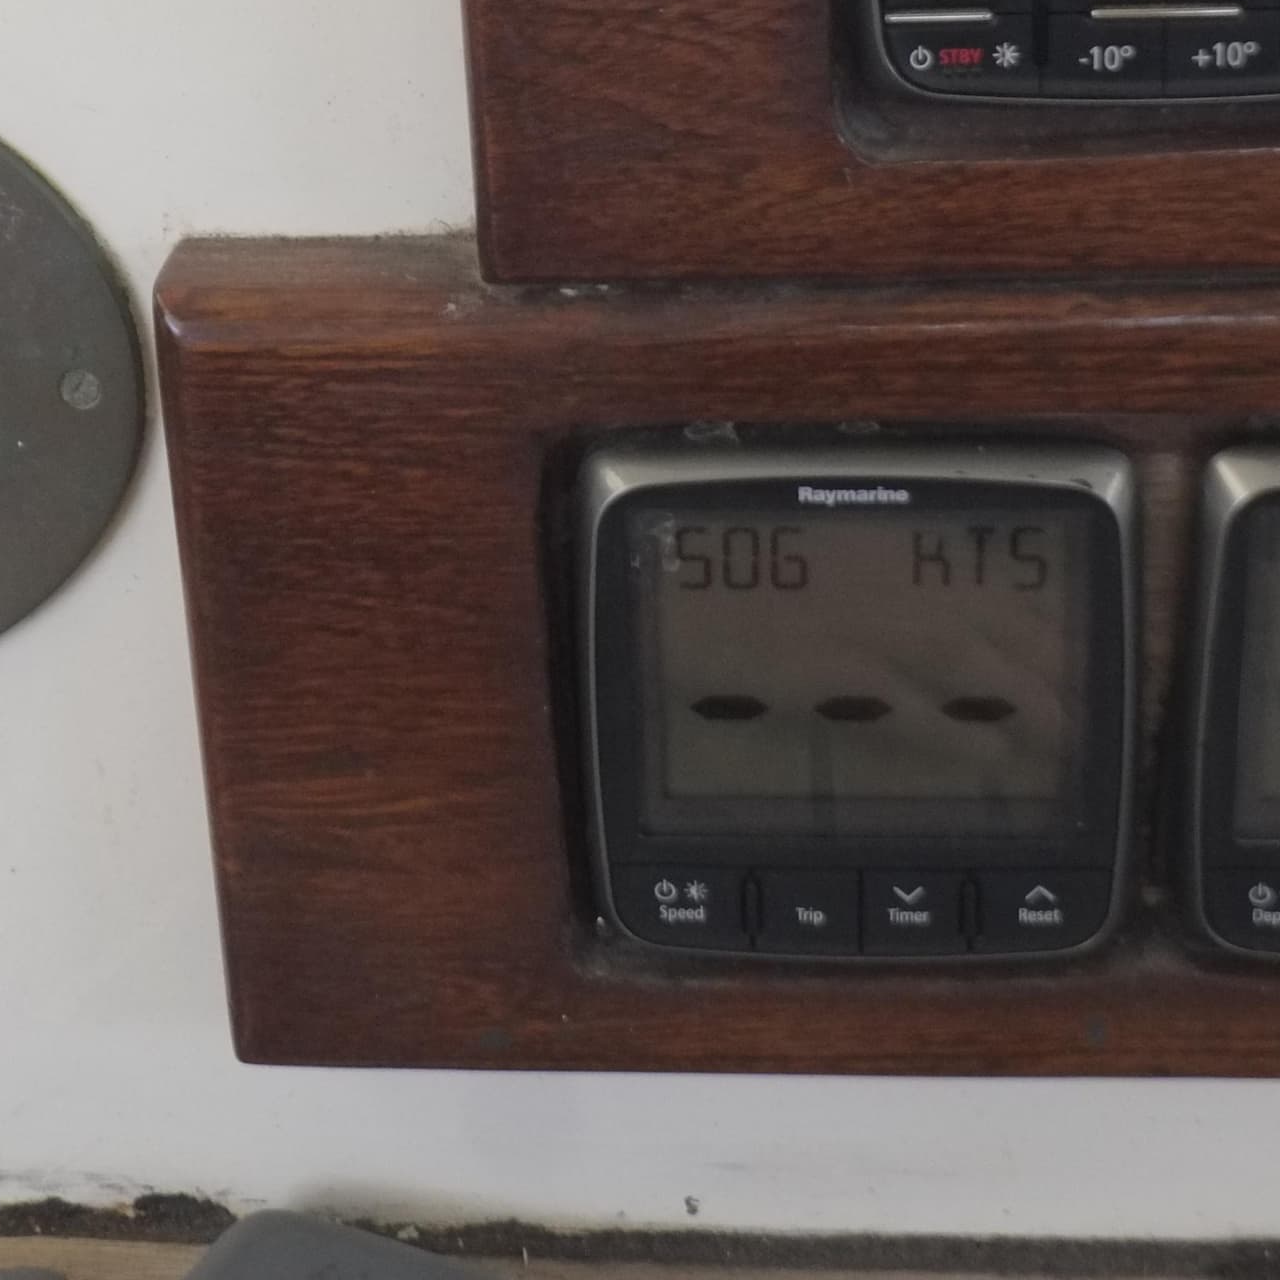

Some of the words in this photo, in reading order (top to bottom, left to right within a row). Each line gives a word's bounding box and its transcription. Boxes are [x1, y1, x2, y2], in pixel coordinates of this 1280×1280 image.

[938, 47, 982, 65] STBY
[797, 486, 909, 505] Raymarine
[675, 526, 810, 591] SOG
[912, 526, 1049, 591] KTS
[658, 904, 705, 922] Speed
[795, 906, 825, 924] Trip
[887, 907, 932, 923] Timer
[1018, 908, 1060, 922] Reset
